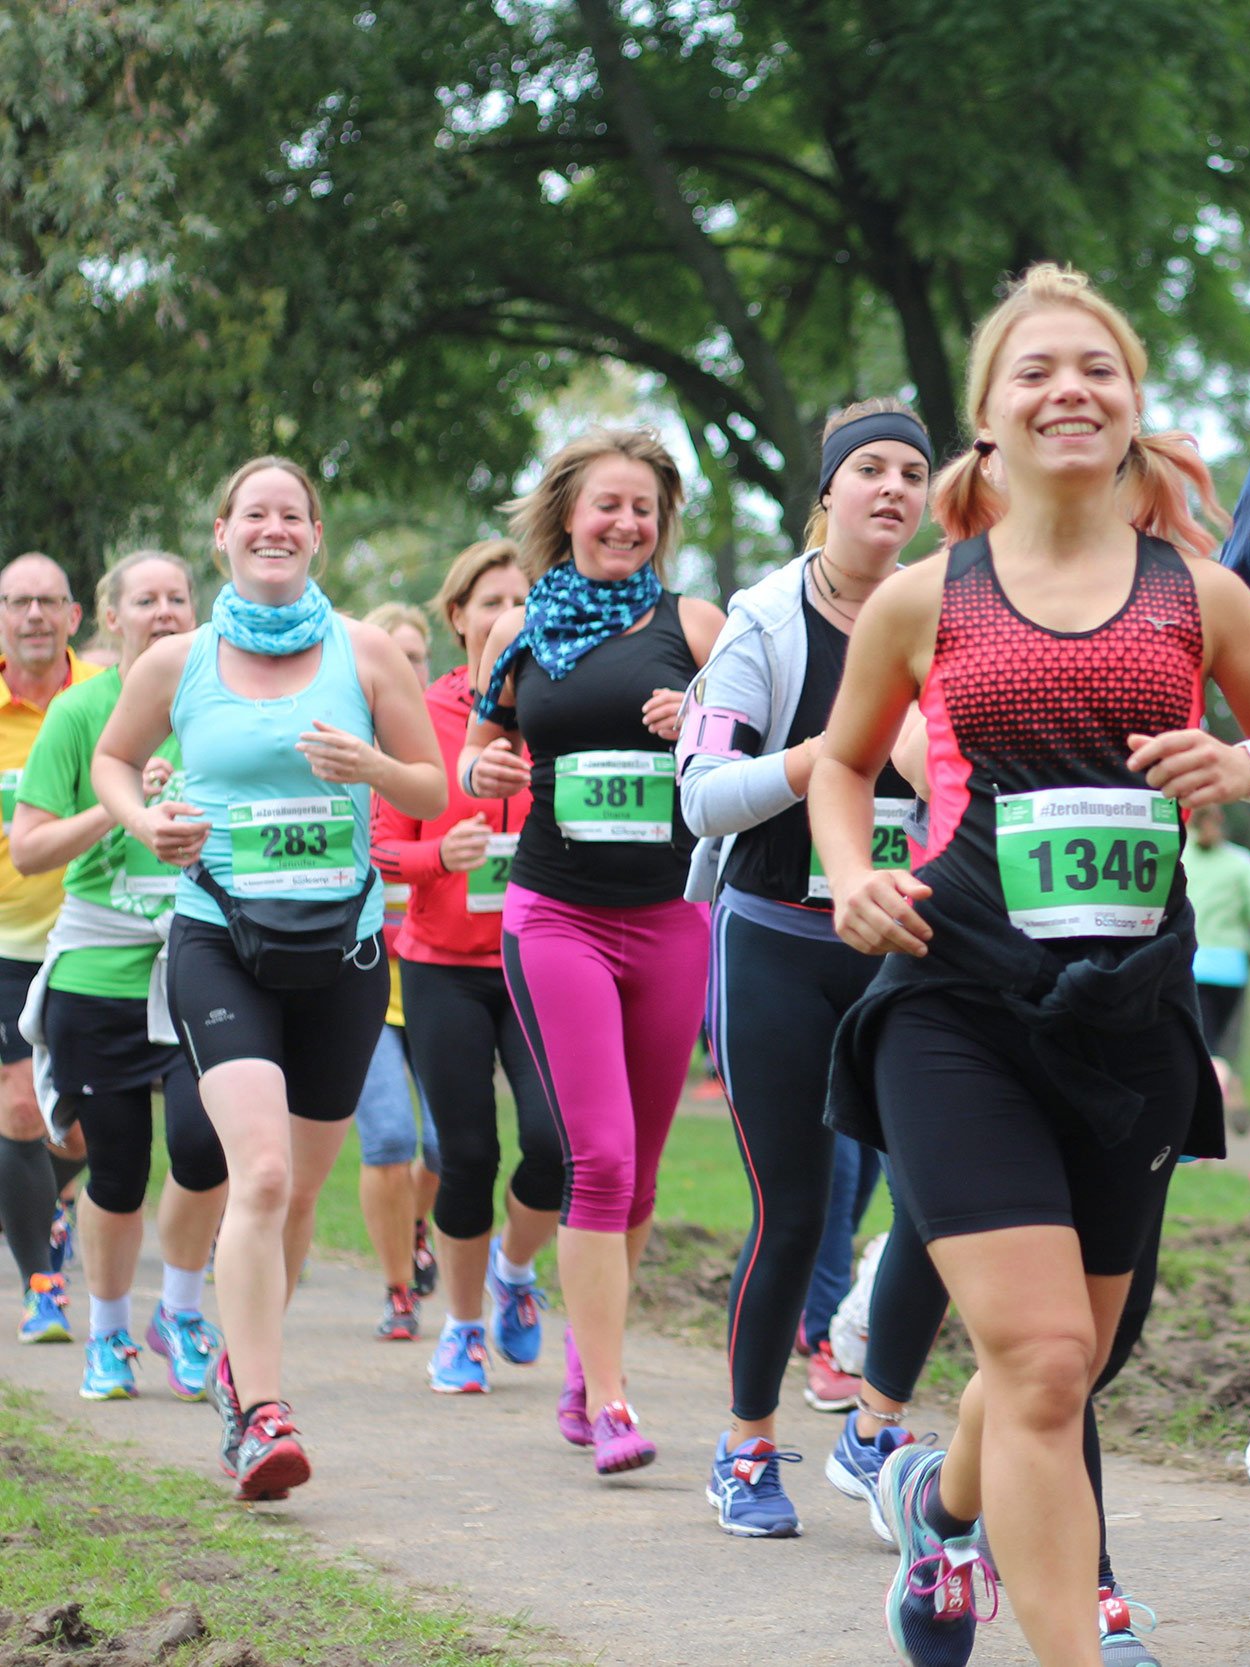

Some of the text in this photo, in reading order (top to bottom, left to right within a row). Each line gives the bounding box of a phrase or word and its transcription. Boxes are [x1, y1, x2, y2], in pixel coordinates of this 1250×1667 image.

[584, 776, 645, 807] 381
[1040, 801, 1147, 817] #ZeroHungerRun
[260, 823, 327, 858] 283
[1028, 838, 1159, 893] 1346
[947, 1575, 963, 1613] 1346
